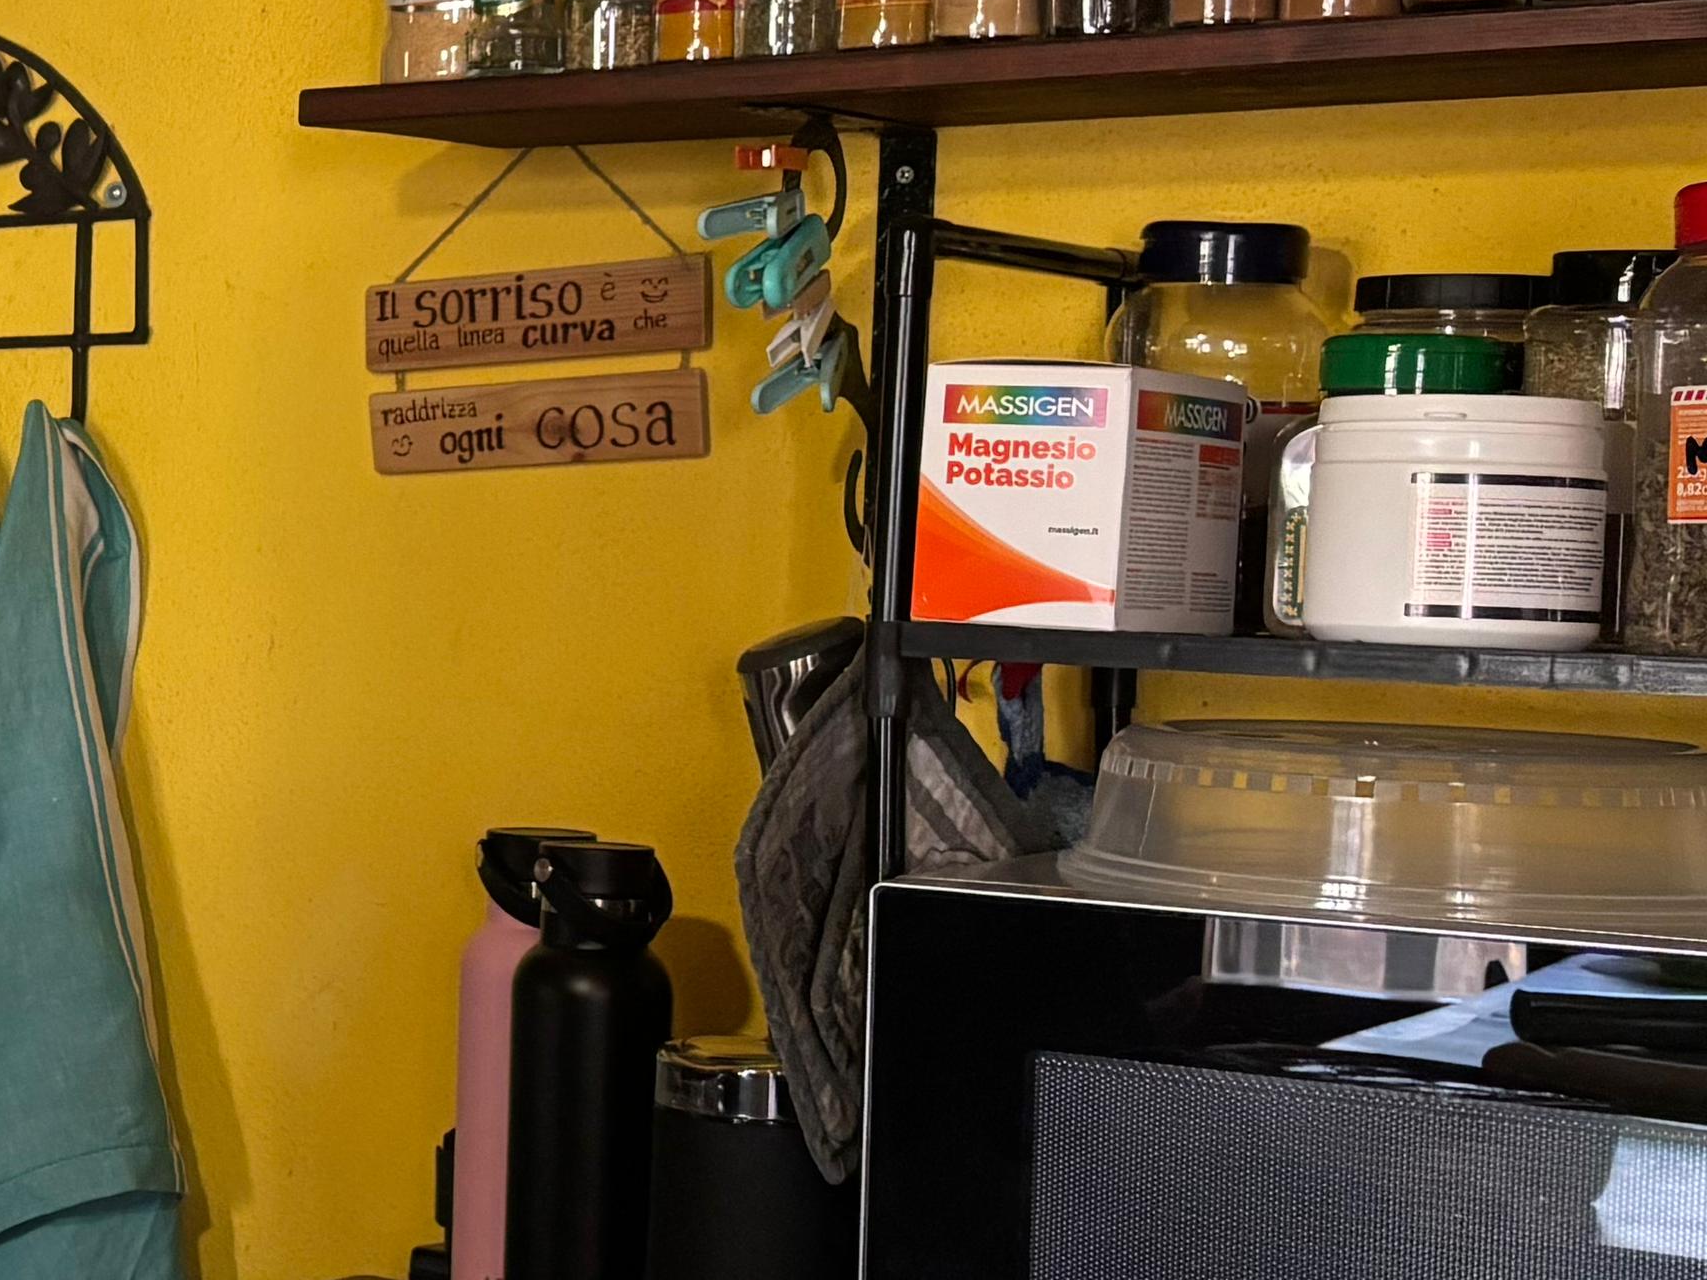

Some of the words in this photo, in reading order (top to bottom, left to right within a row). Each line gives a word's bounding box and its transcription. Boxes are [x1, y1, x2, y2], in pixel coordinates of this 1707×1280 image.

[374, 289, 400, 321] Il
[600, 272, 616, 302] è
[377, 329, 440, 368] quella
[456, 323, 506, 349] linea
[521, 318, 616, 350] curva
[632, 308, 668, 332] che
[380, 396, 478, 428] raddrizza
[956, 394, 1095, 418] MASSIGEN
[1163, 402, 1229, 432] MASSIGEN
[438, 413, 505, 465] ogni
[947, 431, 1097, 465] Magnesio
[945, 460, 1075, 490] Potassio
